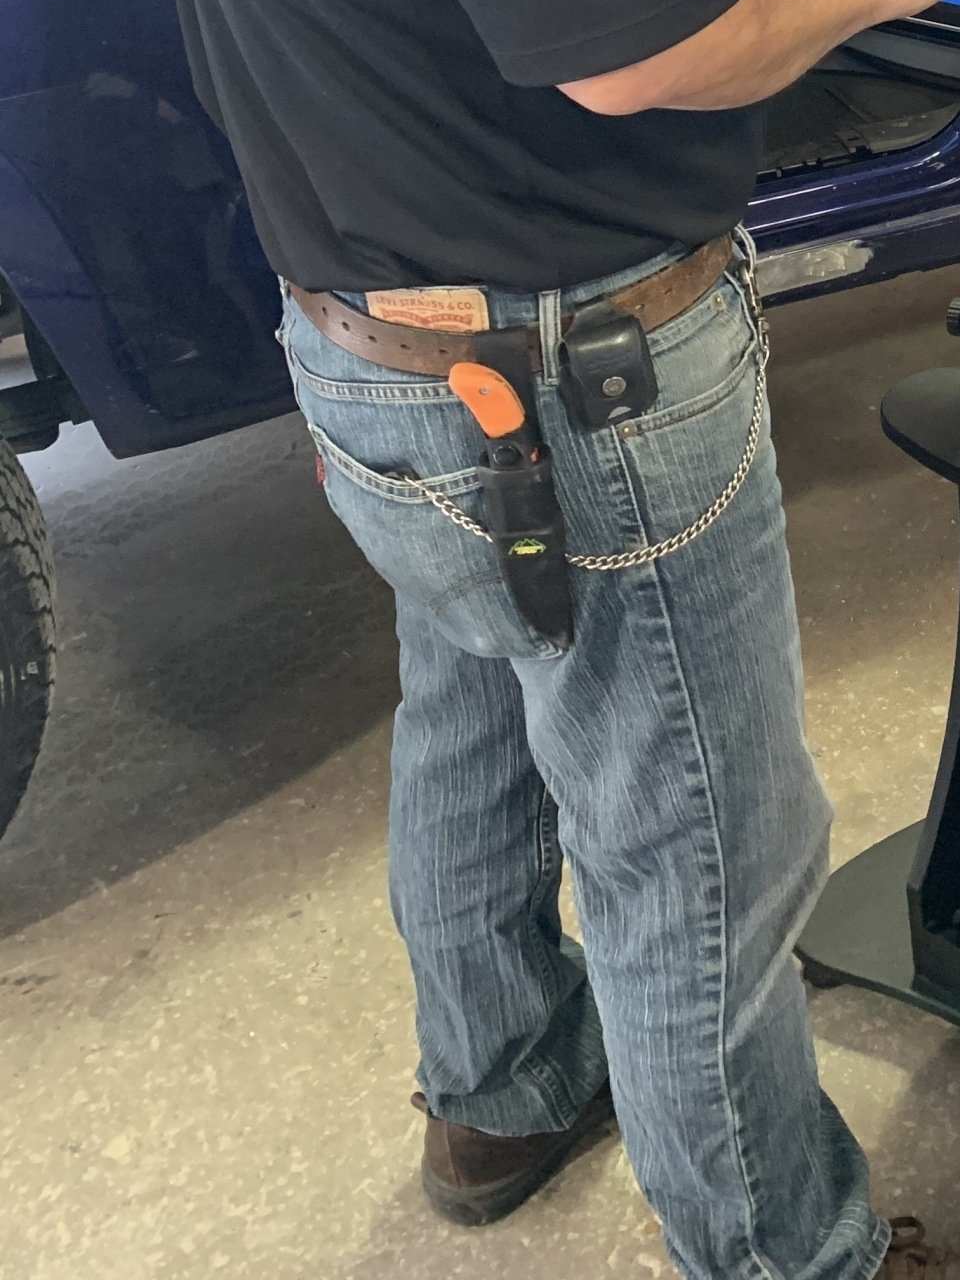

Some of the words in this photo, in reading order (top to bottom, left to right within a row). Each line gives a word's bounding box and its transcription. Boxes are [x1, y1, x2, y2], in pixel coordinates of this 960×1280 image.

[375, 296, 397, 306] LEVI
[400, 298, 444, 309] STRAUSS
[447, 302, 454, 310] &
[457, 301, 475, 310] CO.
